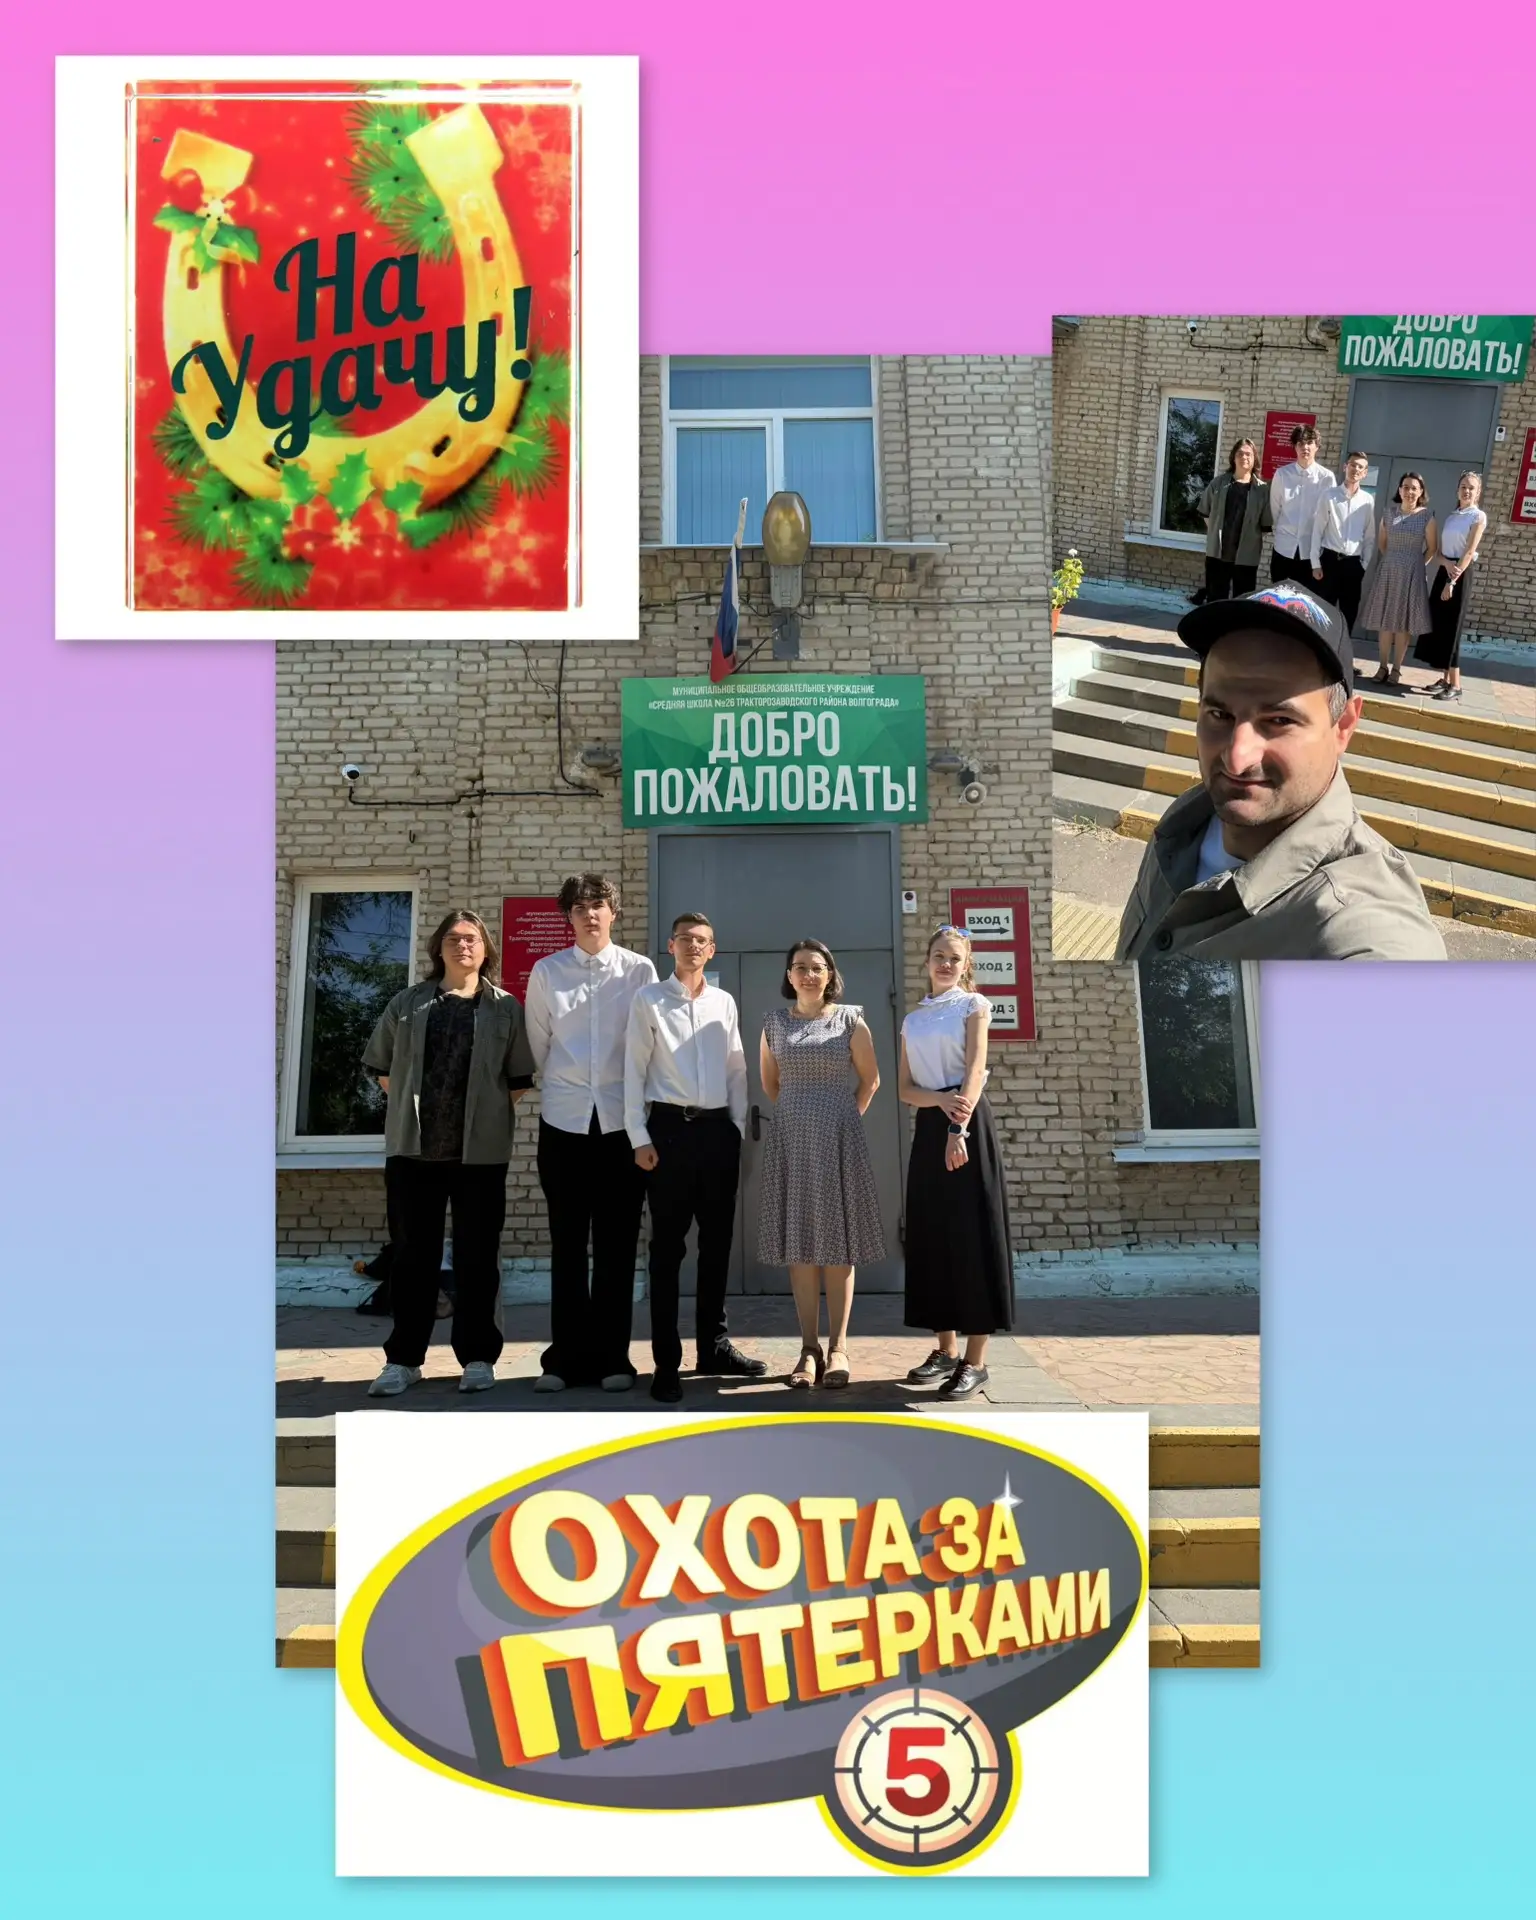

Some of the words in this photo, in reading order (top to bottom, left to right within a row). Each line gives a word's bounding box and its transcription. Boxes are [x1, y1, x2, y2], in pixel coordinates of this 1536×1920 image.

[272, 231, 425, 342] На
[1344, 335, 1523, 375] ПОЖАЛОВАТЬ!
[170, 286, 533, 459] Удачу!
[672, 684, 737, 696] МУНИЦИПАЛЬНОЕ
[737, 683, 825, 695] ОБЩЕОБРАЗОВАТЕЛЬНОЕ
[826, 683, 875, 694] УЧРЕЖДЕНИЕ
[686, 698, 713, 709] ШКОЛА
[714, 698, 735, 708] №26
[736, 697, 818, 708] ТРАКТОРОЗАВОДСКОГО
[819, 695, 848, 707] РАЙОНА
[708, 711, 840, 764] ДОБРО
[633, 764, 917, 816] ПОЖАЛОВАТЬ!
[968, 916, 1001, 925] ВХОД
[1004, 915, 1010, 924] 1
[1006, 963, 1013, 971] 2
[1008, 1004, 1015, 1013] 3
